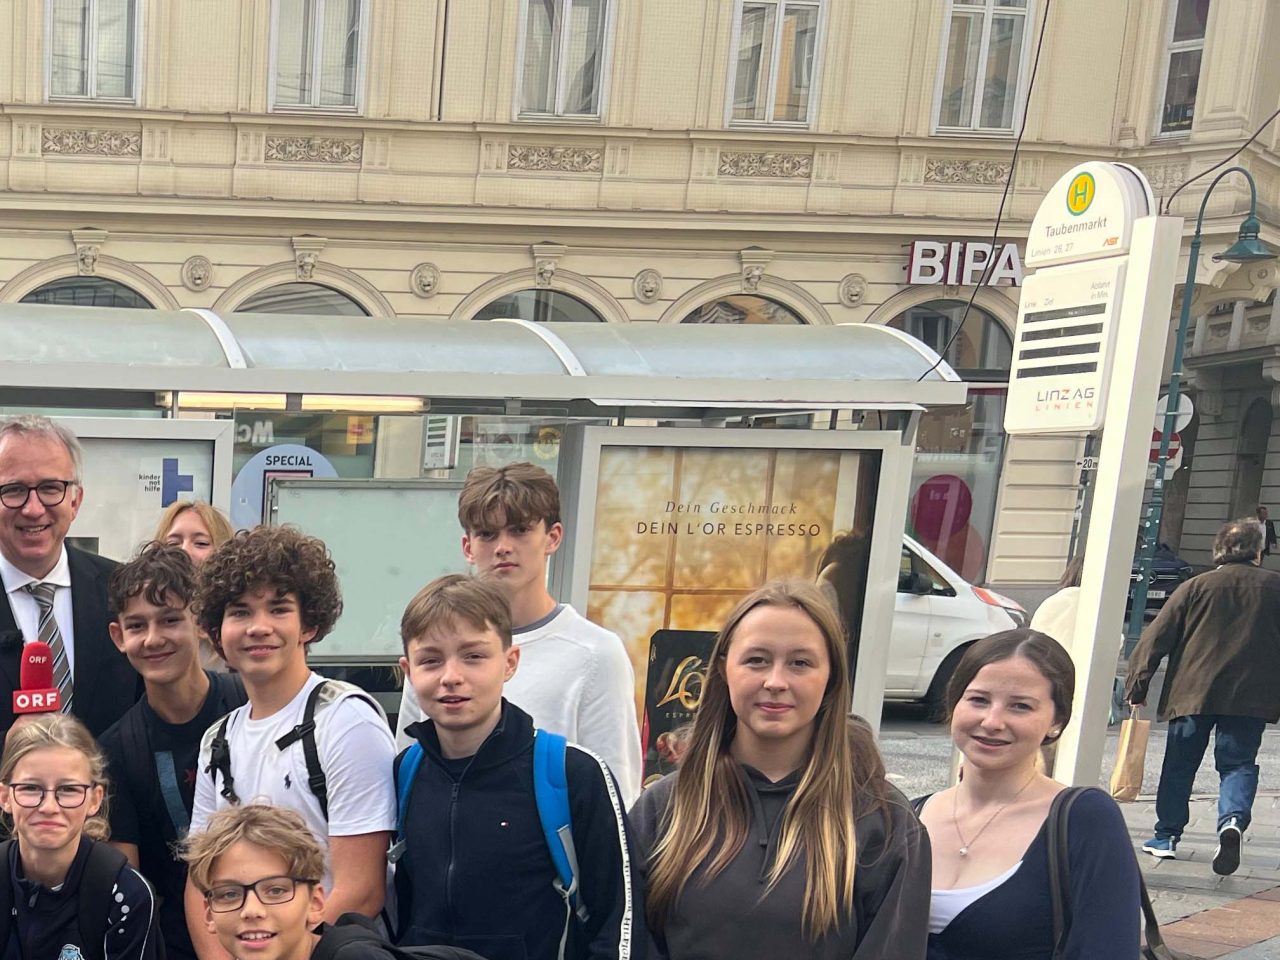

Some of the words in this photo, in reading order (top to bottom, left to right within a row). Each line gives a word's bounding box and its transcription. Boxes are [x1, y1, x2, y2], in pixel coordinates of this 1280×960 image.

[1073, 181, 1088, 207] H
[1045, 217, 1107, 238] Taubenmarkt
[908, 241, 1023, 287] BIPA
[266, 455, 313, 466] SPECIAL
[665, 501, 701, 514] Dein
[710, 501, 798, 515] Geschmack
[637, 522, 678, 534] DEIN
[734, 523, 821, 537] ESPRESSO
[28, 655, 47, 664] ORF
[16, 692, 57, 708] ORF
